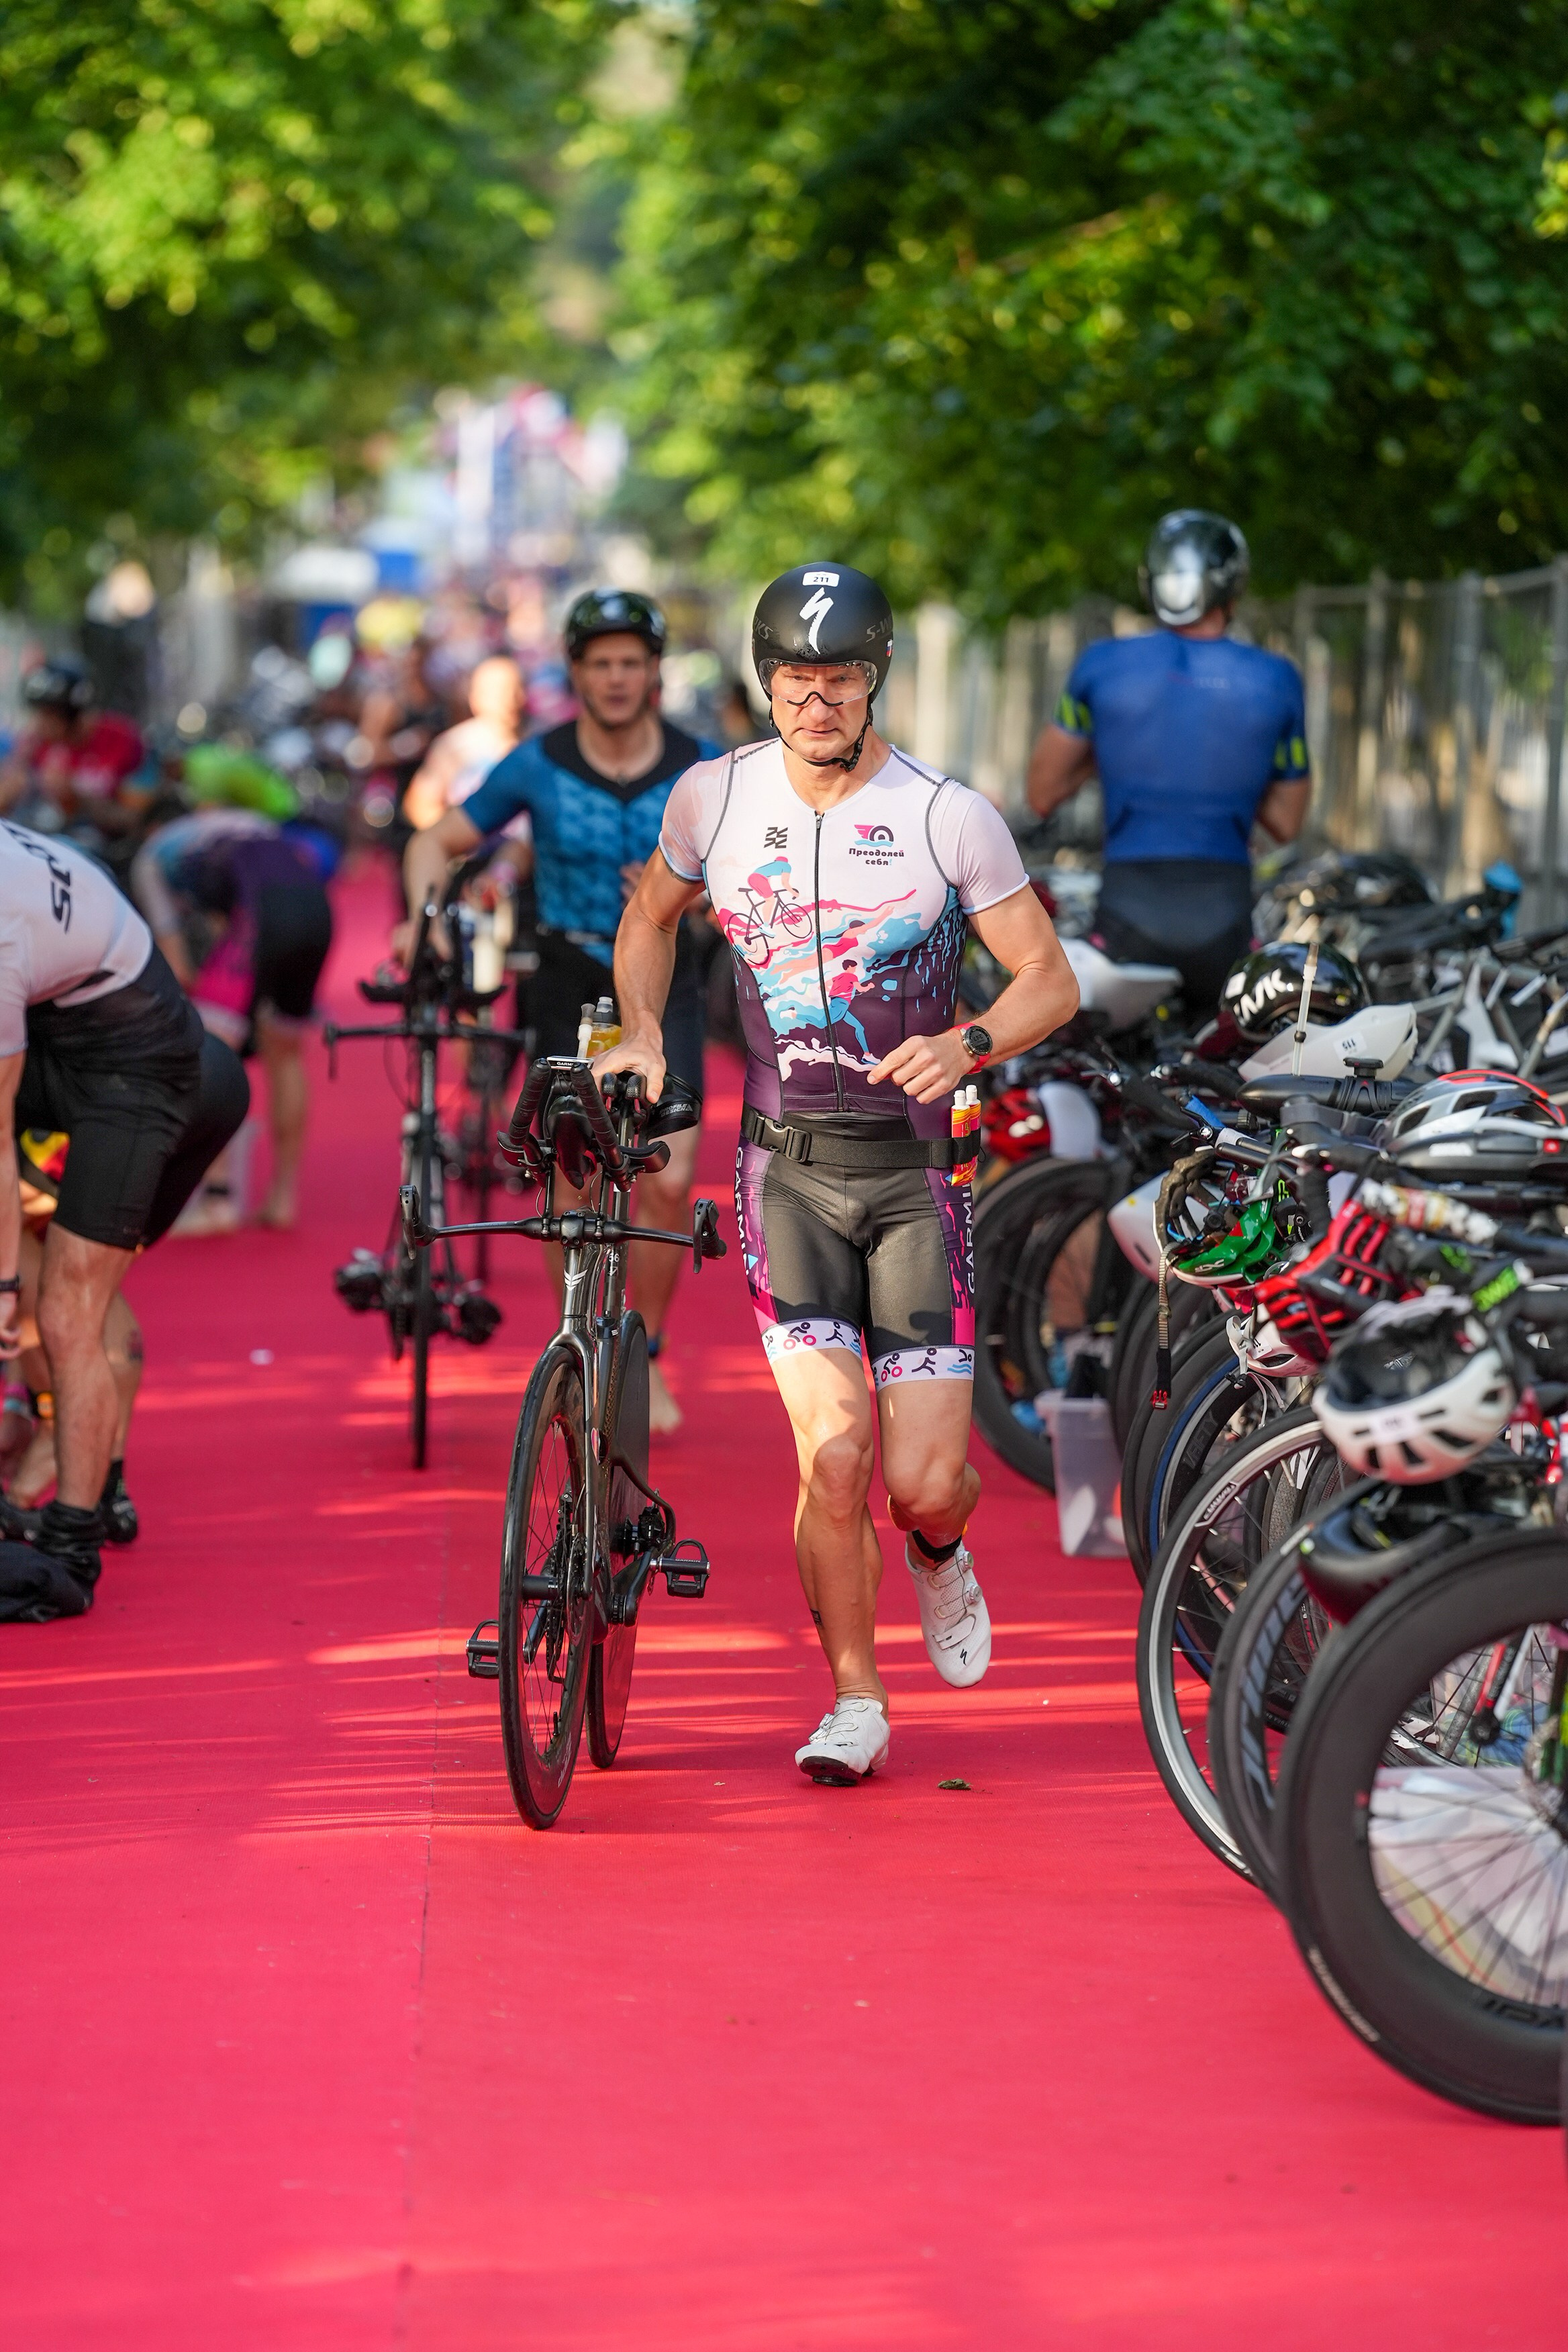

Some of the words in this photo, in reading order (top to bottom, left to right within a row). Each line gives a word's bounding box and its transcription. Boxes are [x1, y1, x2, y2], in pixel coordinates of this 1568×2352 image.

[812, 575, 830, 583] 211
[848, 848, 905, 858] Преодолей
[608, 1253, 620, 1262] 56
